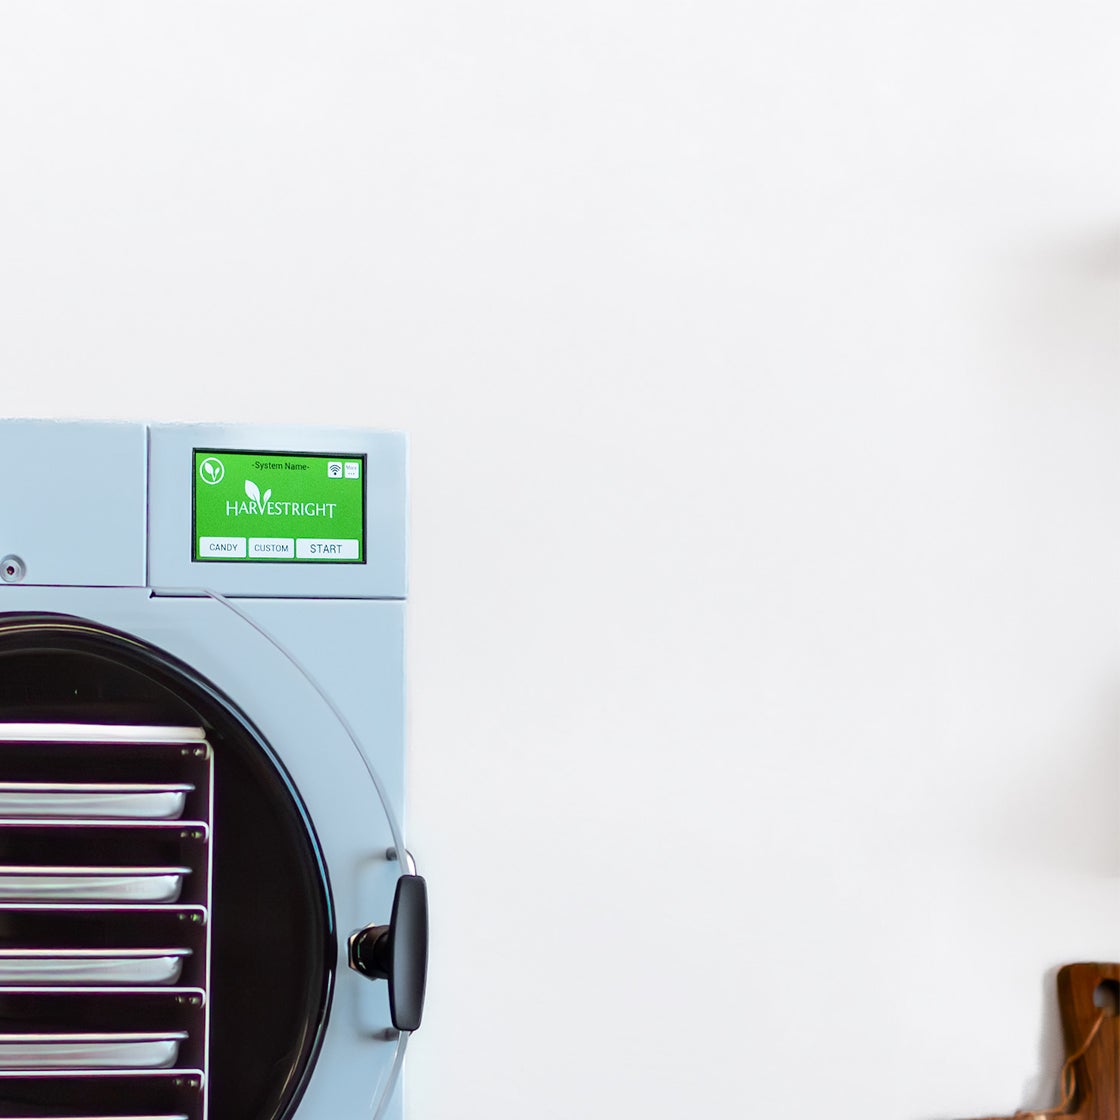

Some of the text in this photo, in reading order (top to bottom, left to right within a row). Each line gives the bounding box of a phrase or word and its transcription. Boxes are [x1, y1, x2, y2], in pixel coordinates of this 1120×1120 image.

[209, 543, 238, 552] CANDY
[254, 544, 289, 552] CUSTOM
[310, 544, 343, 554] START
